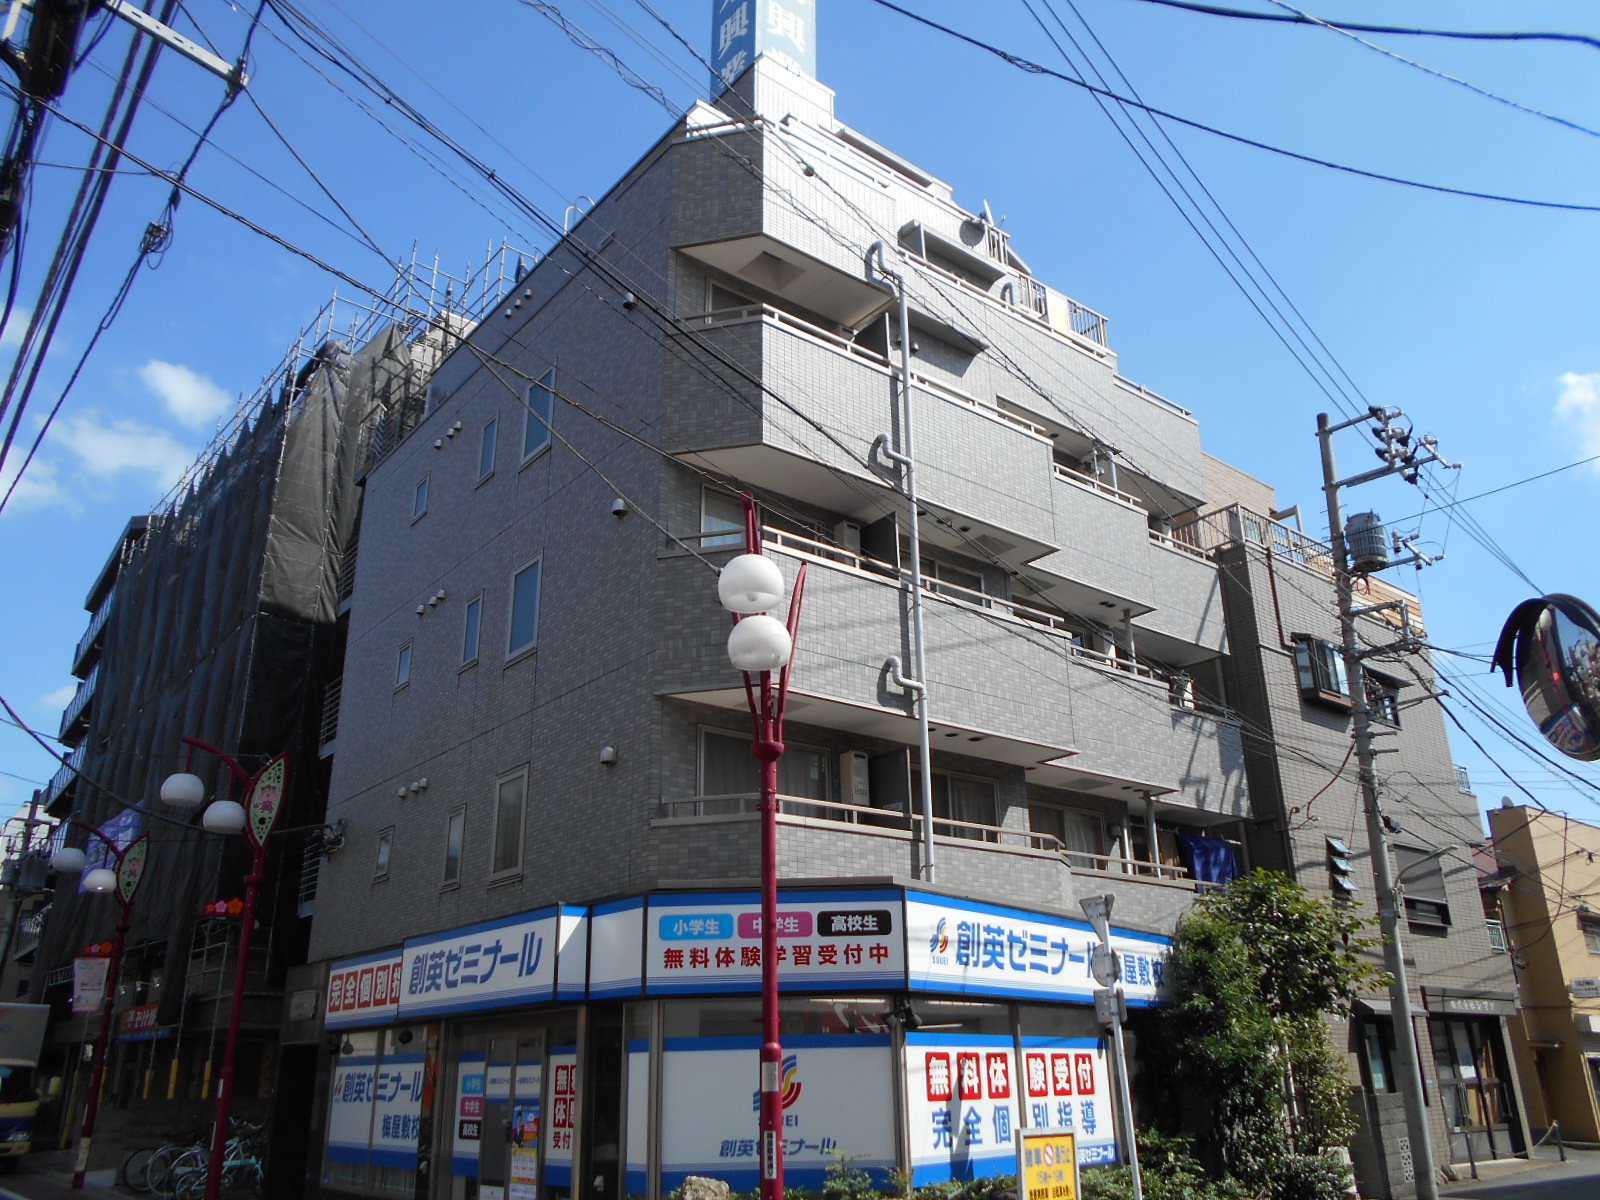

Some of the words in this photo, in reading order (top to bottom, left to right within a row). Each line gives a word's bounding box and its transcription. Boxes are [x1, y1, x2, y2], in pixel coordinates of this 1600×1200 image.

[718, 0, 750, 88] 興業
[673, 918, 720, 935] 小学生
[830, 914, 878, 932] 高校生
[408, 931, 543, 995] 創英ゼミナール
[932, 955, 949, 966] SOUEI
[1118, 953, 1165, 988] 屋敷校
[928, 1057, 1093, 1096] 無料体験受付
[464, 1100, 480, 1114] 中学生
[462, 1123, 479, 1137] 高校生
[552, 1130, 571, 1149] 受付
[1078, 1145, 1114, 1165] 英ゼミナール
